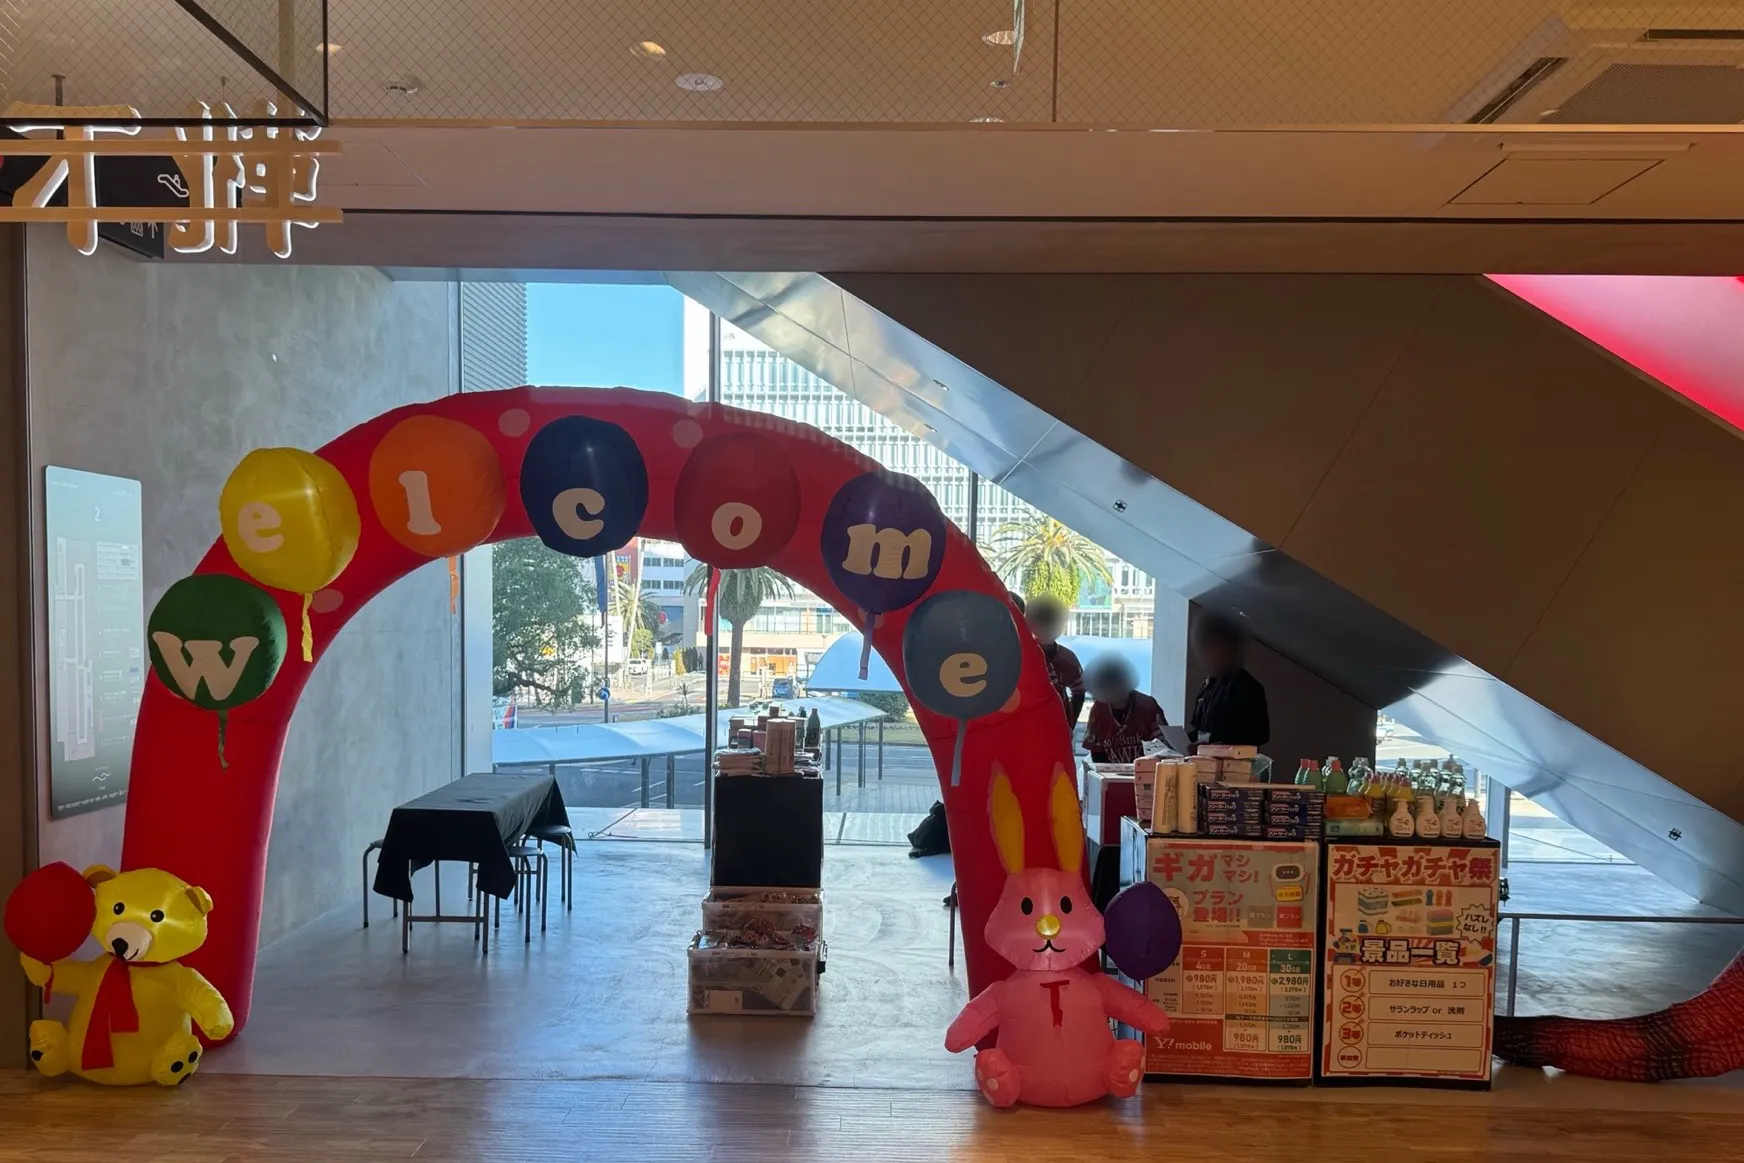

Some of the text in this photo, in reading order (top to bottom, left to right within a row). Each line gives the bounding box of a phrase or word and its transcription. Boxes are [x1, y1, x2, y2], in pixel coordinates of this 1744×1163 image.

[1220, 853, 1251, 868] マシ
[1332, 853, 1493, 881] ガチャガチャ祭
[1153, 852, 1217, 883] ギガ
[1464, 913, 1490, 924] ハズレ
[1361, 938, 1460, 966] 景品一覧
[1389, 979, 1445, 988] お好きな日用品
[1389, 1005, 1430, 1014] サランラップ
[1394, 1030, 1452, 1040] ポケットティッシュ
